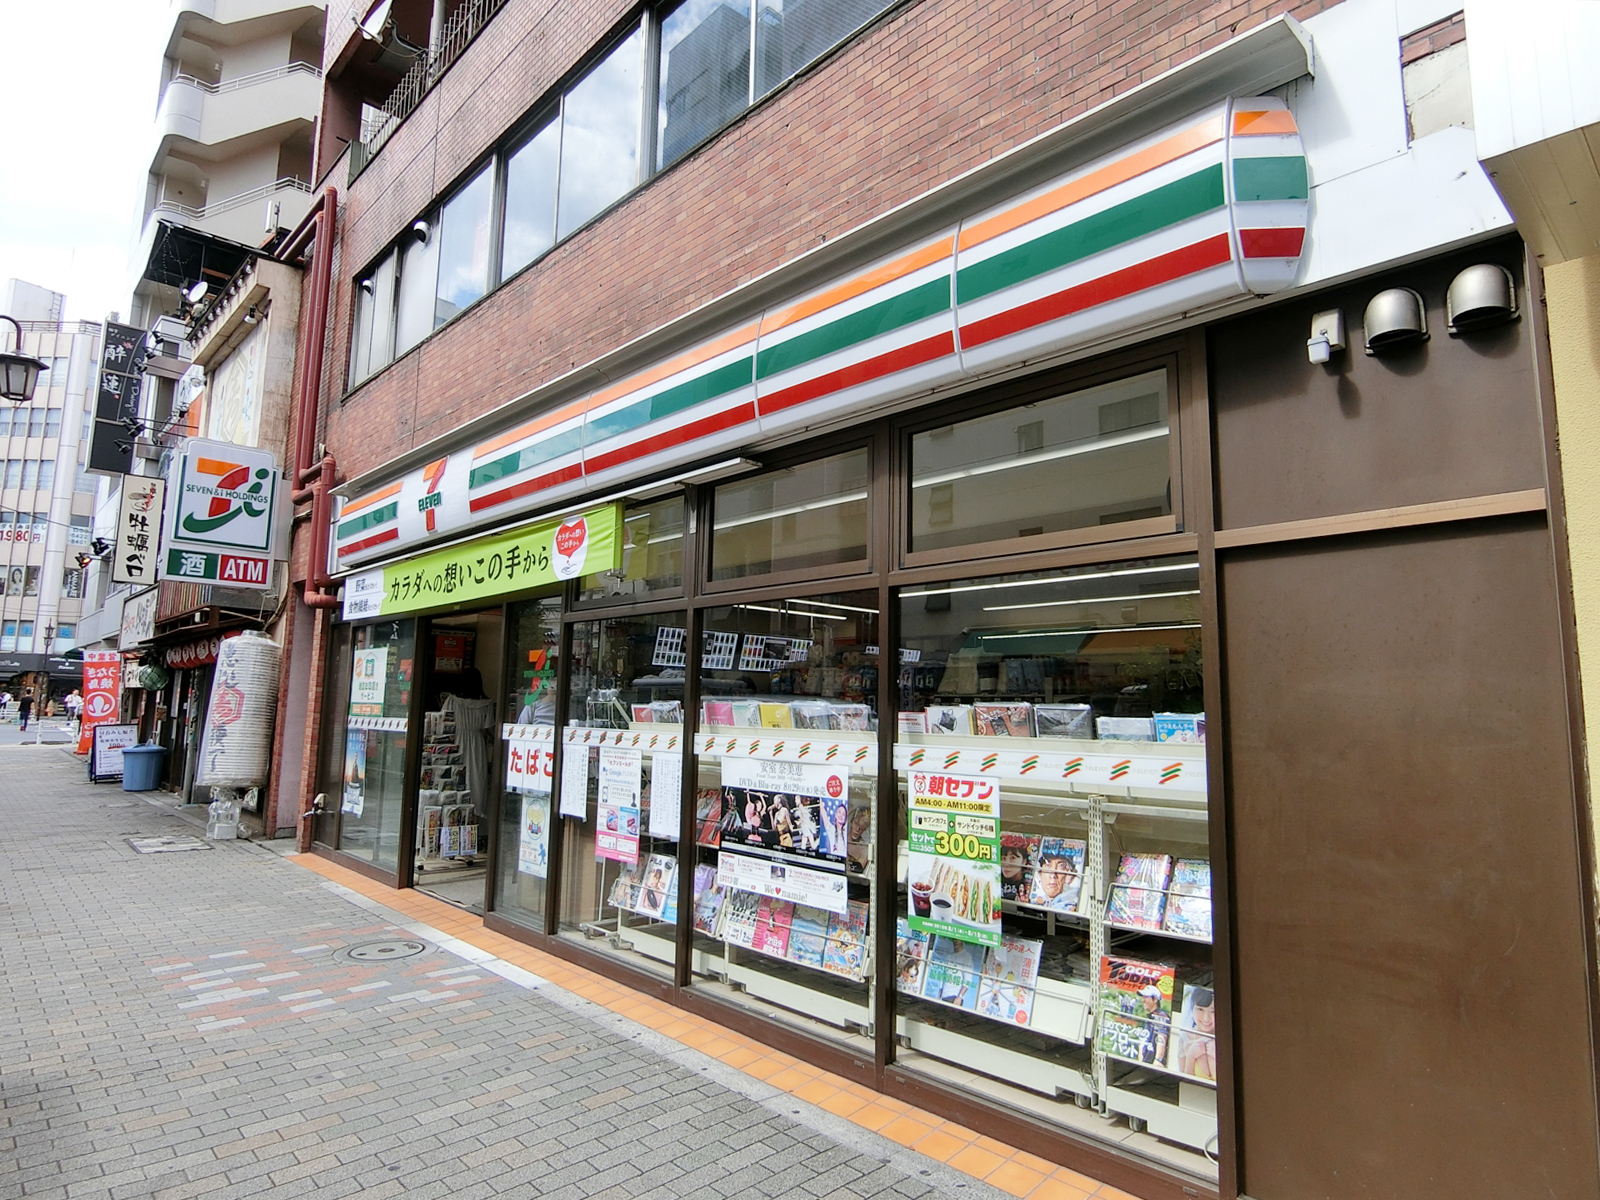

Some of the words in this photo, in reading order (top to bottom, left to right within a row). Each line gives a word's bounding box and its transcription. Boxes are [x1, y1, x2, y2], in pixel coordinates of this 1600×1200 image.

[225, 490, 268, 504] HOLDINGS
[179, 552, 207, 576] 酒
[223, 558, 264, 582] ATM
[389, 545, 549, 603] カラダへの想いこの手から
[510, 747, 554, 777] たばこ
[928, 775, 994, 800] 朝セブン
[935, 831, 991, 860] 300円
[1125, 965, 1161, 978] GOLF
